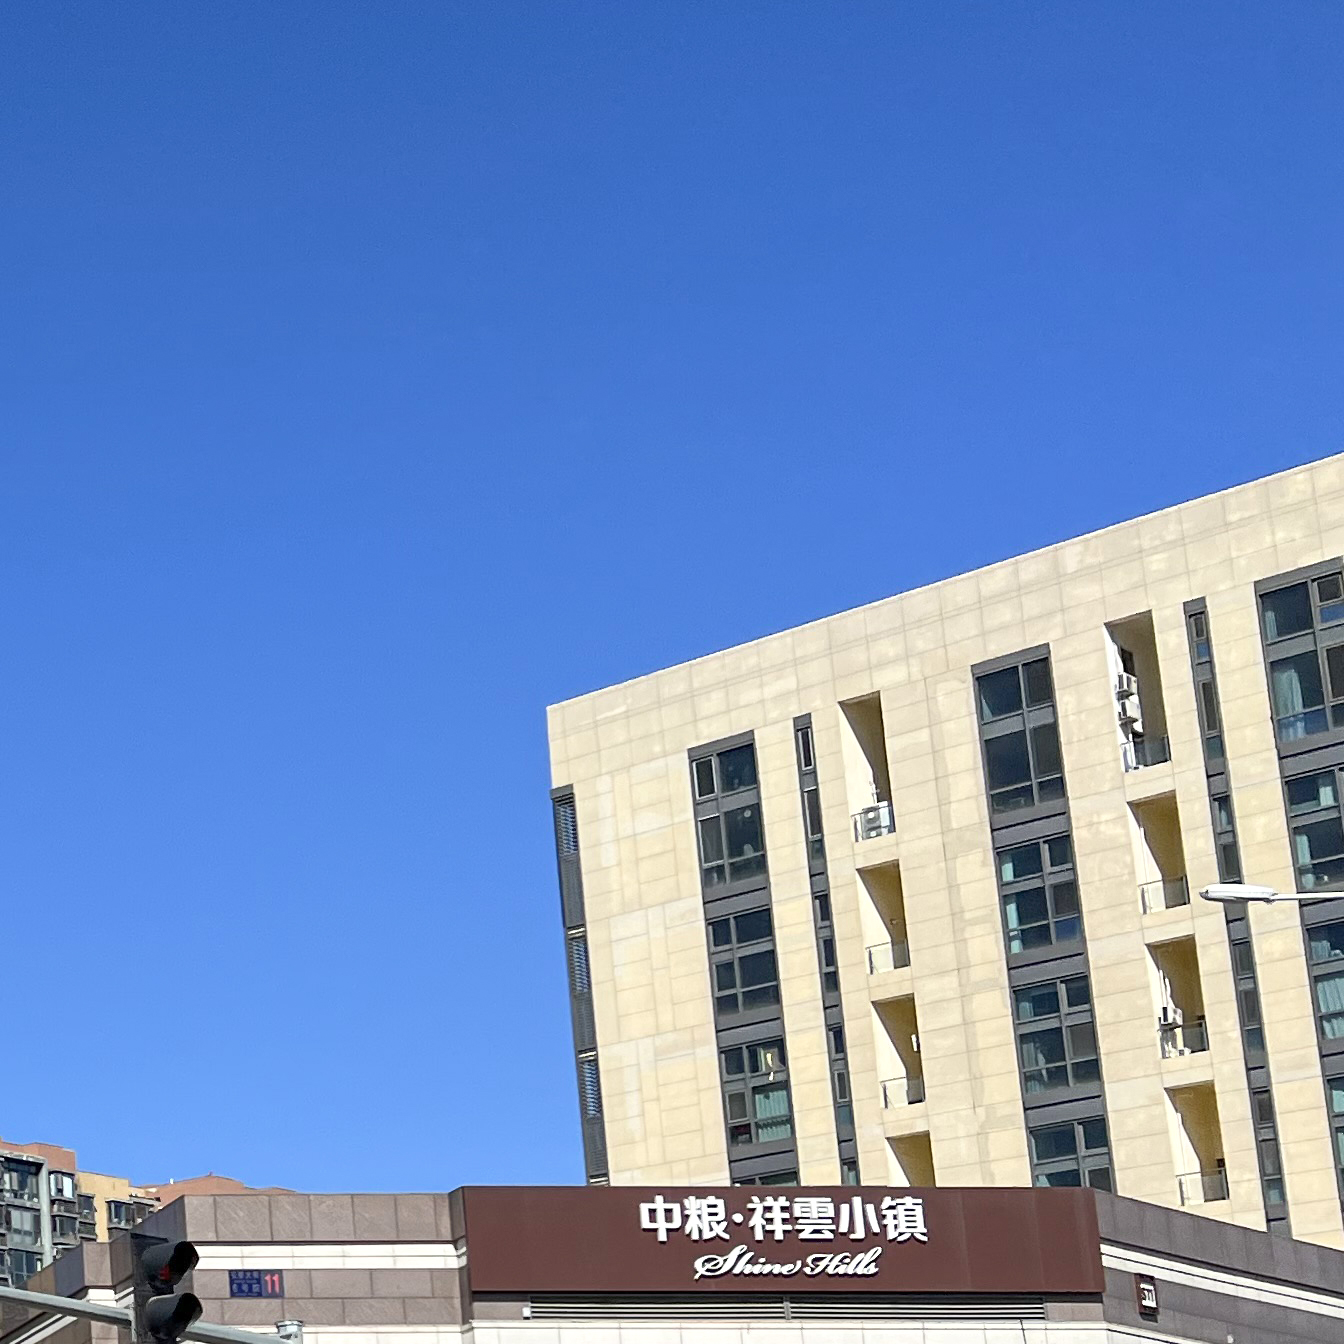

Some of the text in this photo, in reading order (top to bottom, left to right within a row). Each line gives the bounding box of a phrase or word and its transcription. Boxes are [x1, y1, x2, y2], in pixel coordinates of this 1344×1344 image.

[639, 1194, 929, 1242] 中粮·祥雲小镇
[693, 1244, 883, 1280] Shine Hills
[264, 1273, 280, 1295] 11
